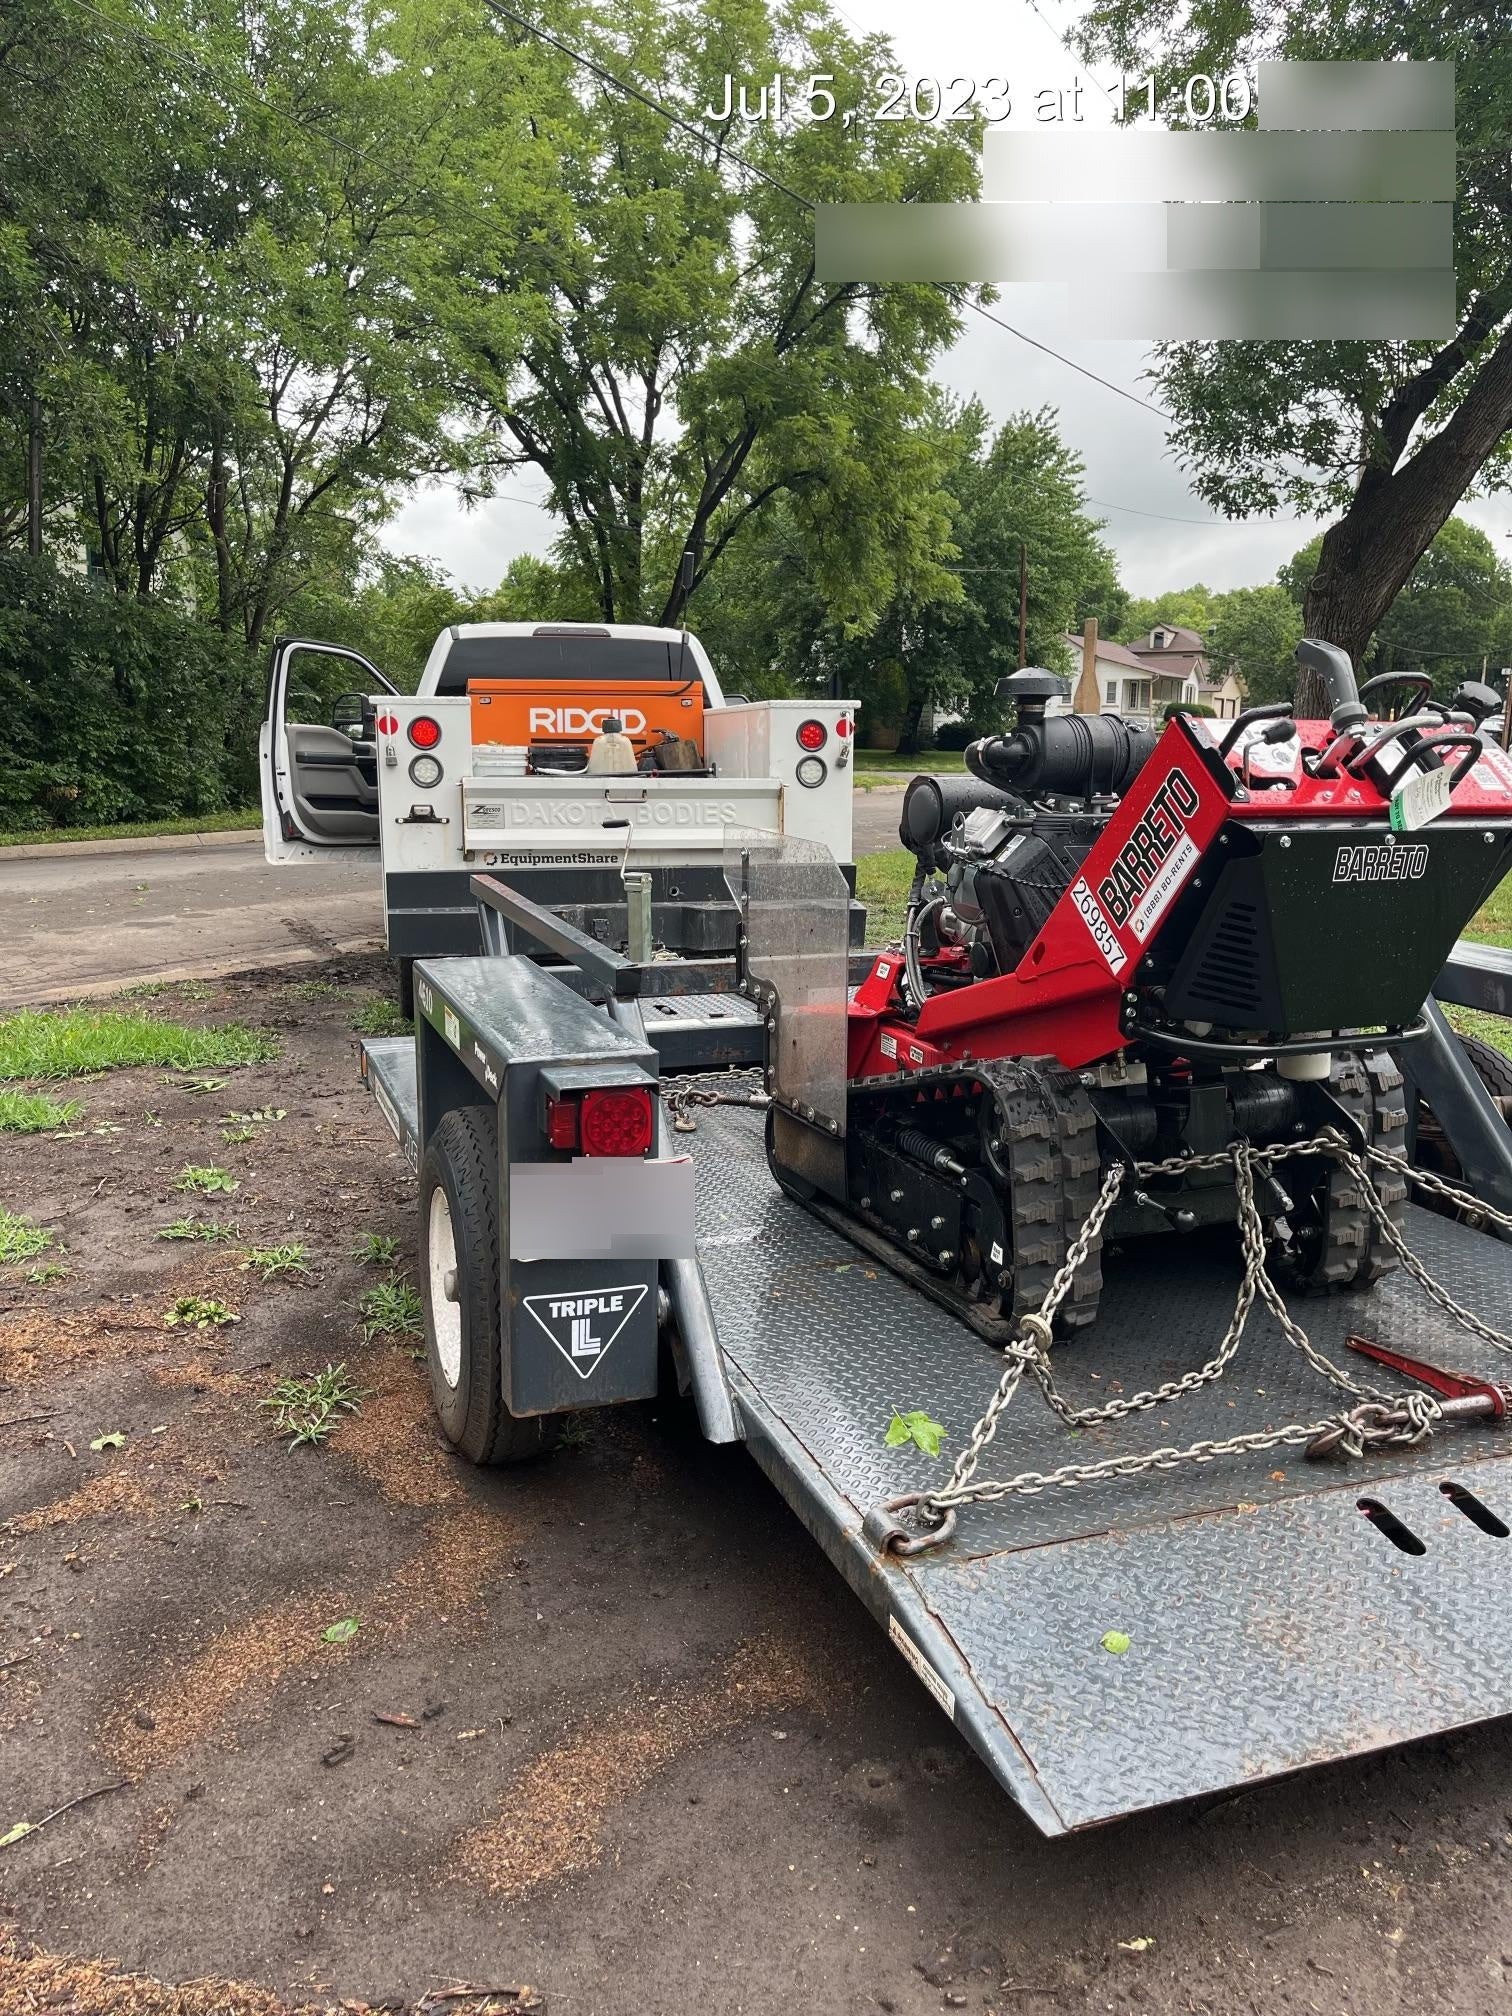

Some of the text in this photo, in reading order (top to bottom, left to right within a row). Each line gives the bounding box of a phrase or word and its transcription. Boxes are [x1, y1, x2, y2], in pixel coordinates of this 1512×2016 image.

[511, 801, 619, 826] DAKOTA
[635, 801, 738, 825] BODIES
[500, 852, 619, 866] EquipmentShare
[1097, 767, 1200, 930] BARRETO
[1332, 844, 1430, 882] BARRETO
[1143, 843, 1193, 918] (888) 80-RENTS
[1072, 879, 1125, 966] 269857
[548, 1294, 624, 1319] TRIPLE
